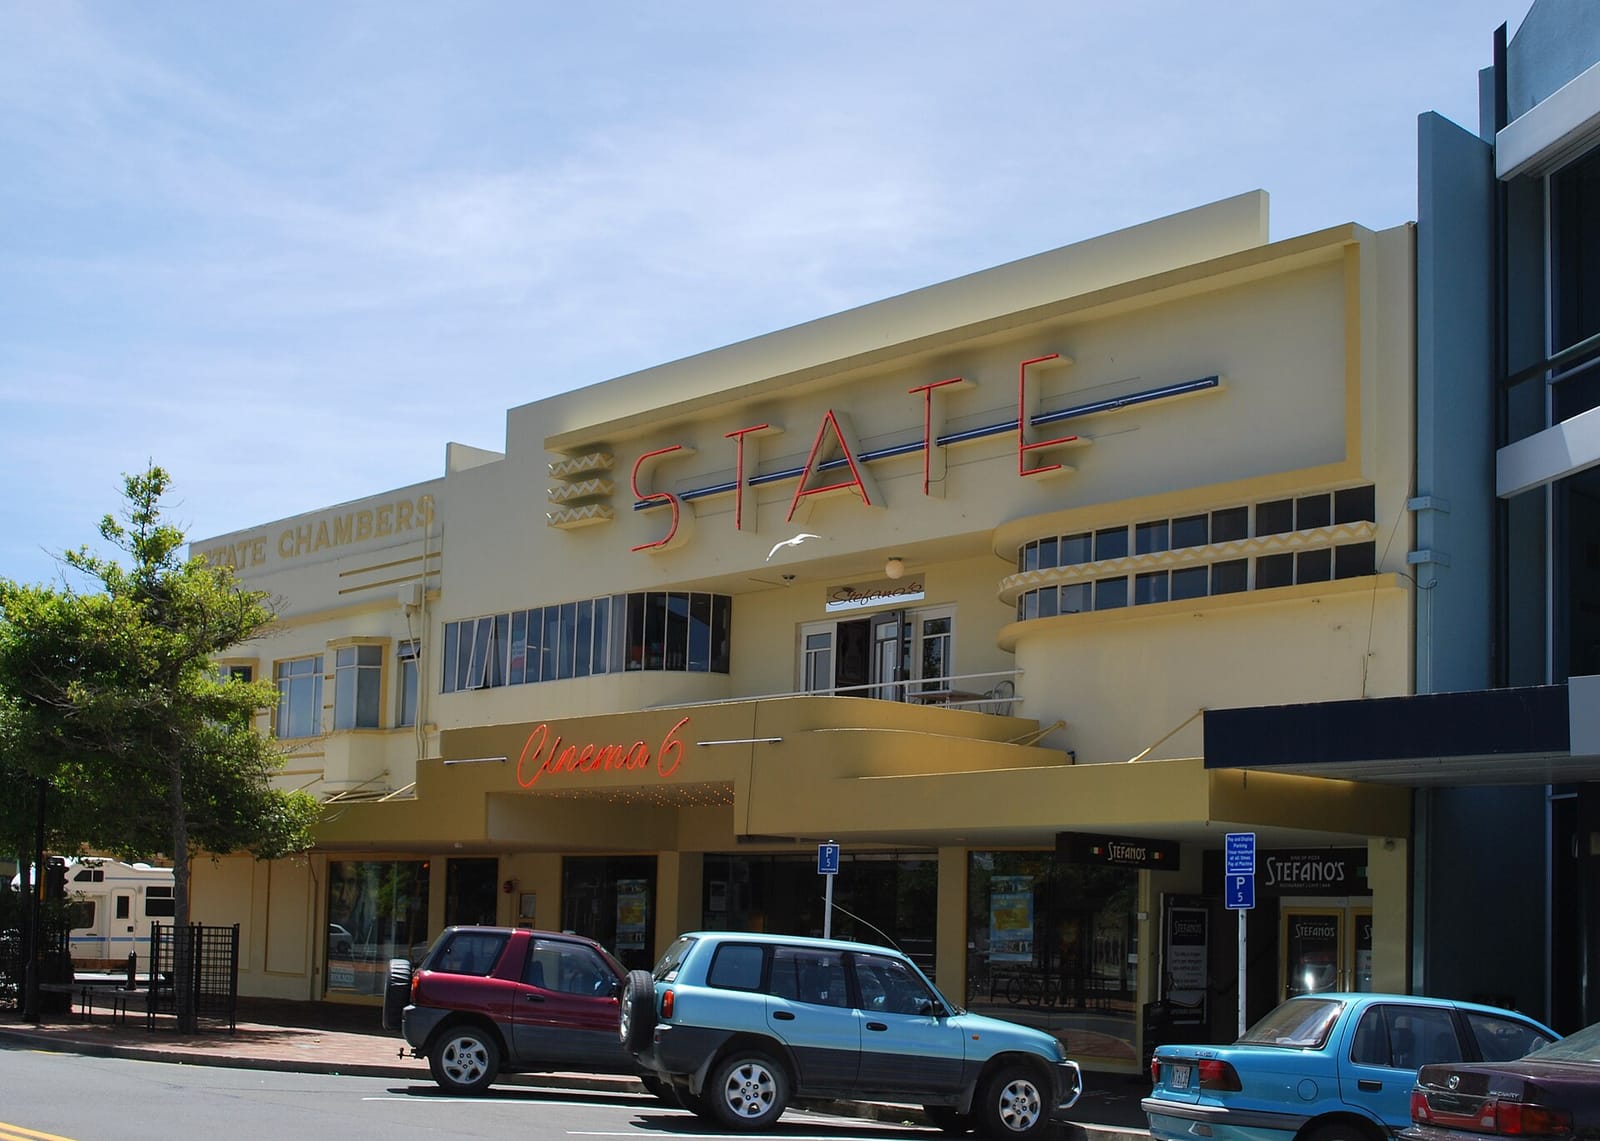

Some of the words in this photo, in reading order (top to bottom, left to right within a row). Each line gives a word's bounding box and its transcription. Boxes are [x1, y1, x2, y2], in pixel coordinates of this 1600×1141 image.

[630, 352, 1086, 552] STATE
[277, 494, 434, 559] CHAMBERS
[829, 582, 922, 606] Stefano's
[517, 723, 651, 788] Cinema
[657, 716, 689, 778] 6
[826, 847, 833, 858] P
[826, 858, 831, 867] 5
[1236, 876, 1246, 890] P
[1265, 856, 1345, 886] STEFANO'S
[1237, 892, 1244, 903] 5
